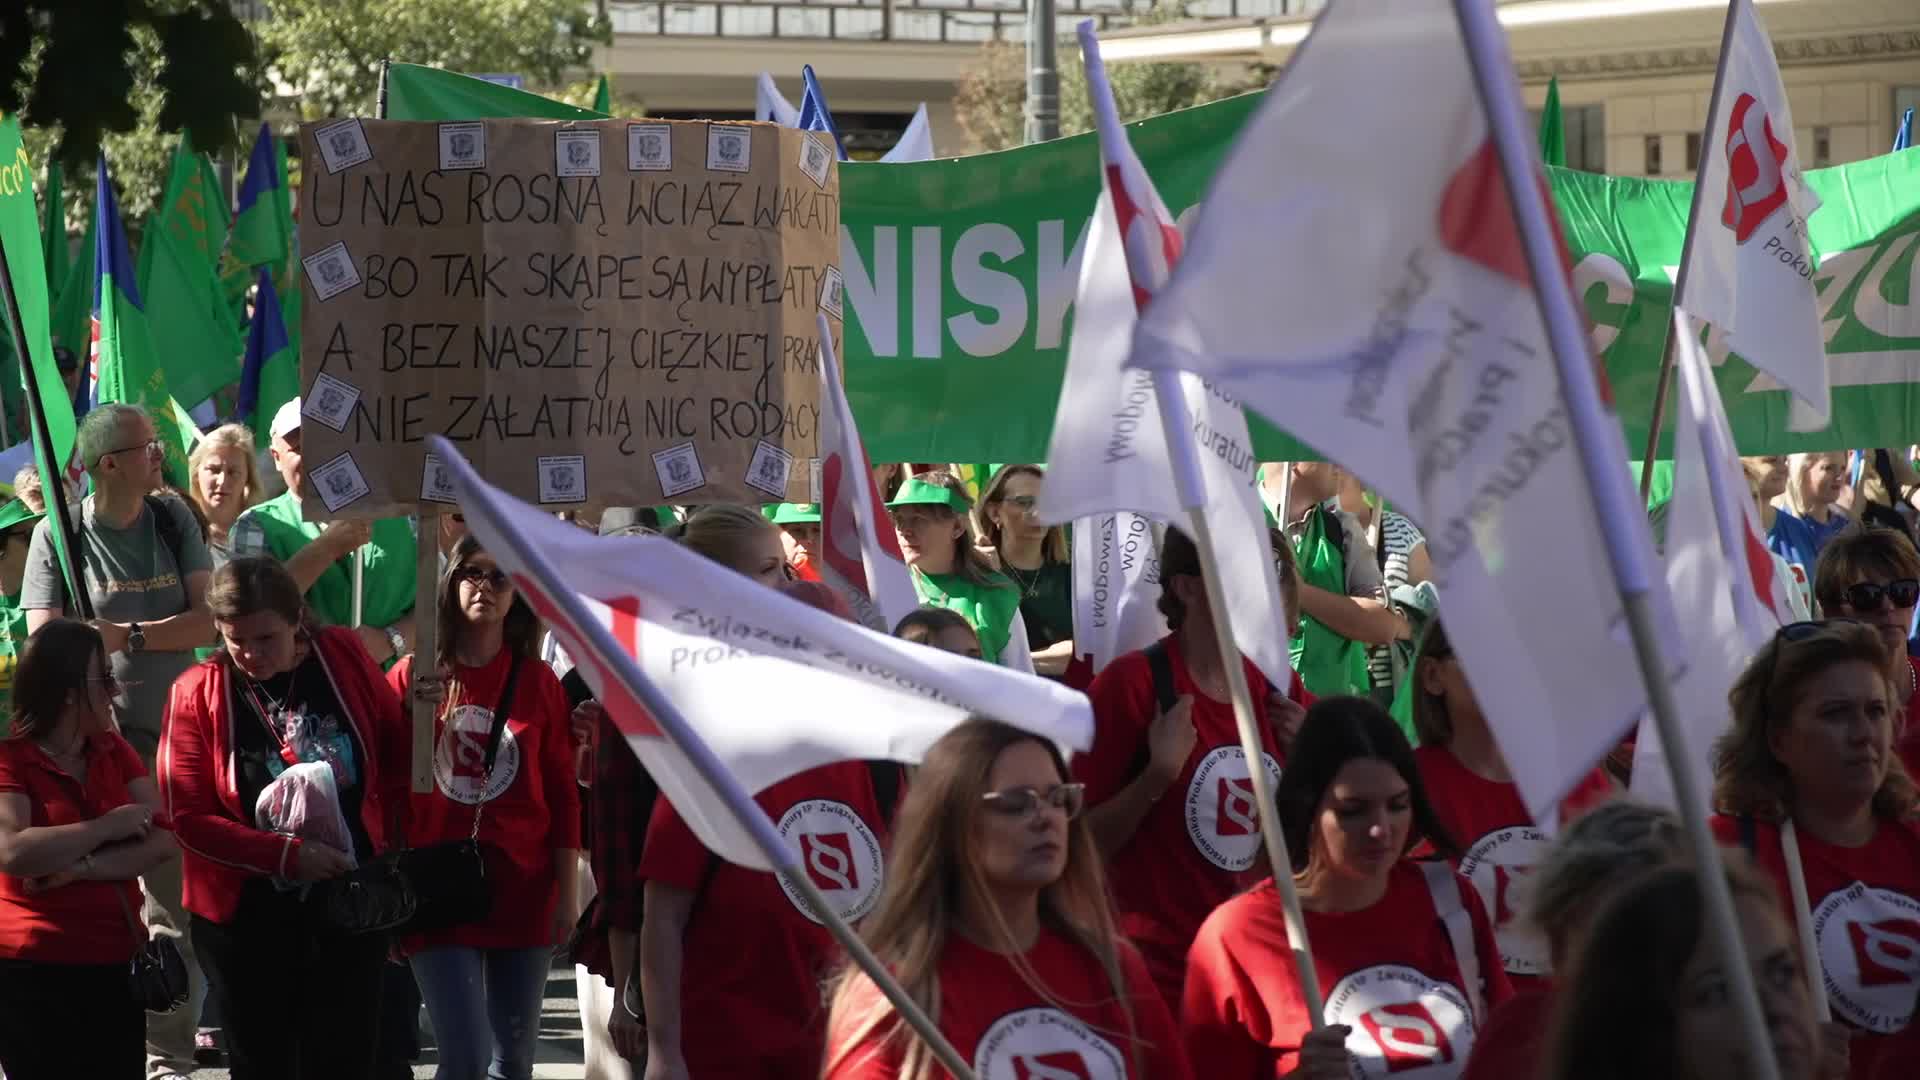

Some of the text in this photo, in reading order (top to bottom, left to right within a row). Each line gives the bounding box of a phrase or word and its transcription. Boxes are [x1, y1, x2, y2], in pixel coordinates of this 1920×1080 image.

[312, 171, 839, 241] U NAS ROSNĄ WCIĄŻ WAKATY
[364, 253, 418, 300] BO
[429, 253, 507, 297] TAK
[522, 256, 643, 312] SKĄPE
[652, 255, 692, 320] SĄ
[700, 257, 826, 313] WYPŁATY
[320, 321, 353, 372] A
[381, 323, 463, 372] BEZ
[473, 323, 616, 401] NASZEJ
[631, 323, 775, 412] CIĘŻKIEJ
[354, 393, 431, 443] NIE
[441, 396, 635, 456] ZAŁATWIĄ
[644, 398, 696, 440] NIC
[709, 397, 821, 459] RODACY
